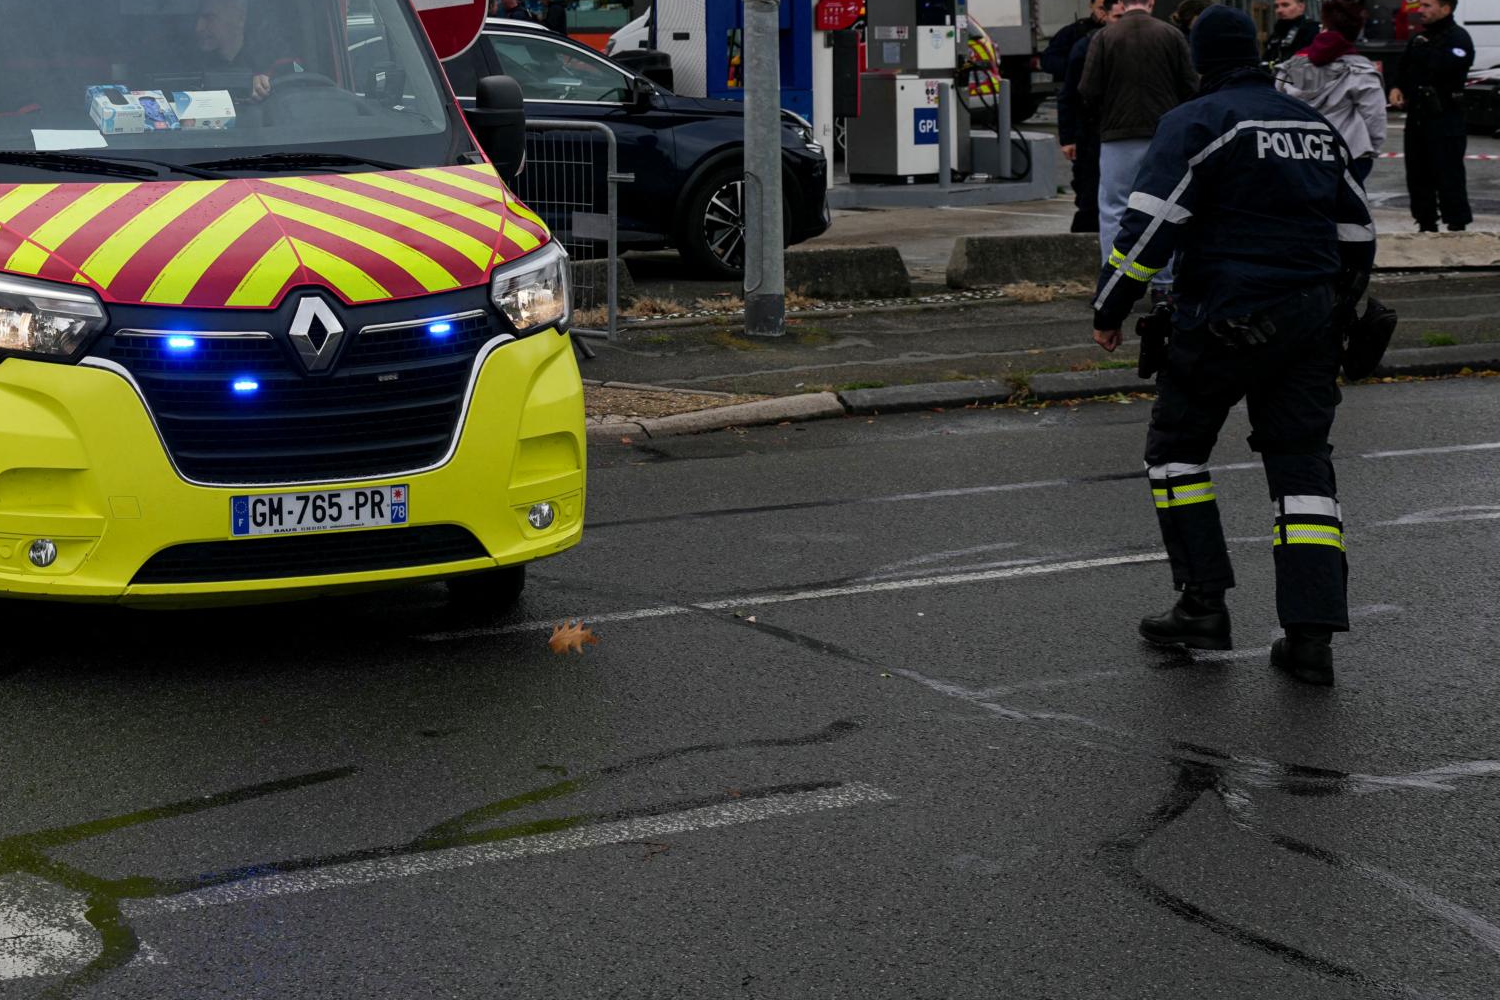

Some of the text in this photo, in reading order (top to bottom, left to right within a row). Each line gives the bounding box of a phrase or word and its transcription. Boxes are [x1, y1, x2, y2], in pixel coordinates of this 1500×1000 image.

[918, 119, 940, 134] GPL
[1256, 130, 1336, 161] POLICE
[252, 489, 385, 528] GM-765-PR
[391, 505, 405, 519] 78
[238, 518, 244, 527] F
